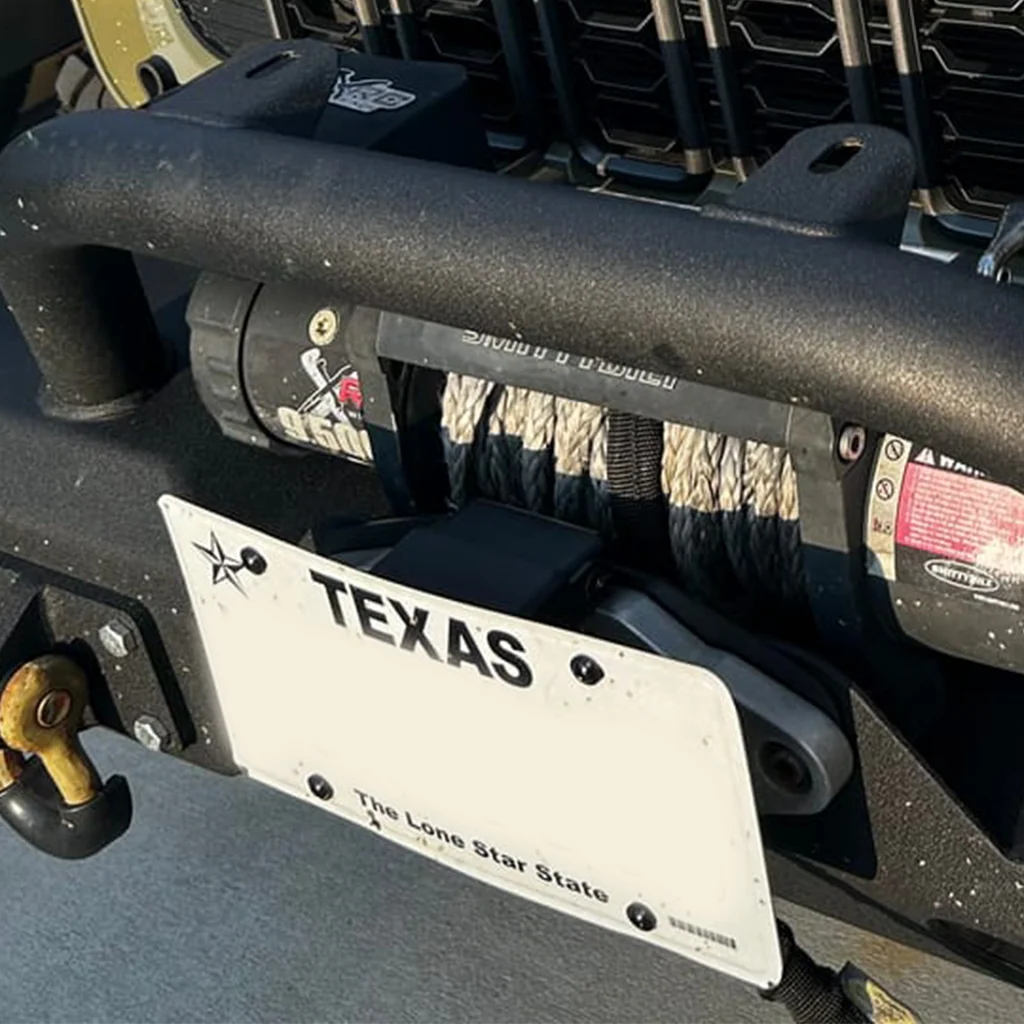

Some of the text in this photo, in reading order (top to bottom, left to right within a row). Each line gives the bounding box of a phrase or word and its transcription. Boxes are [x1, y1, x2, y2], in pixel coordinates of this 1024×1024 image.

[308, 568, 534, 689] TEXAS
[353, 787, 610, 904] The Lone Star State
